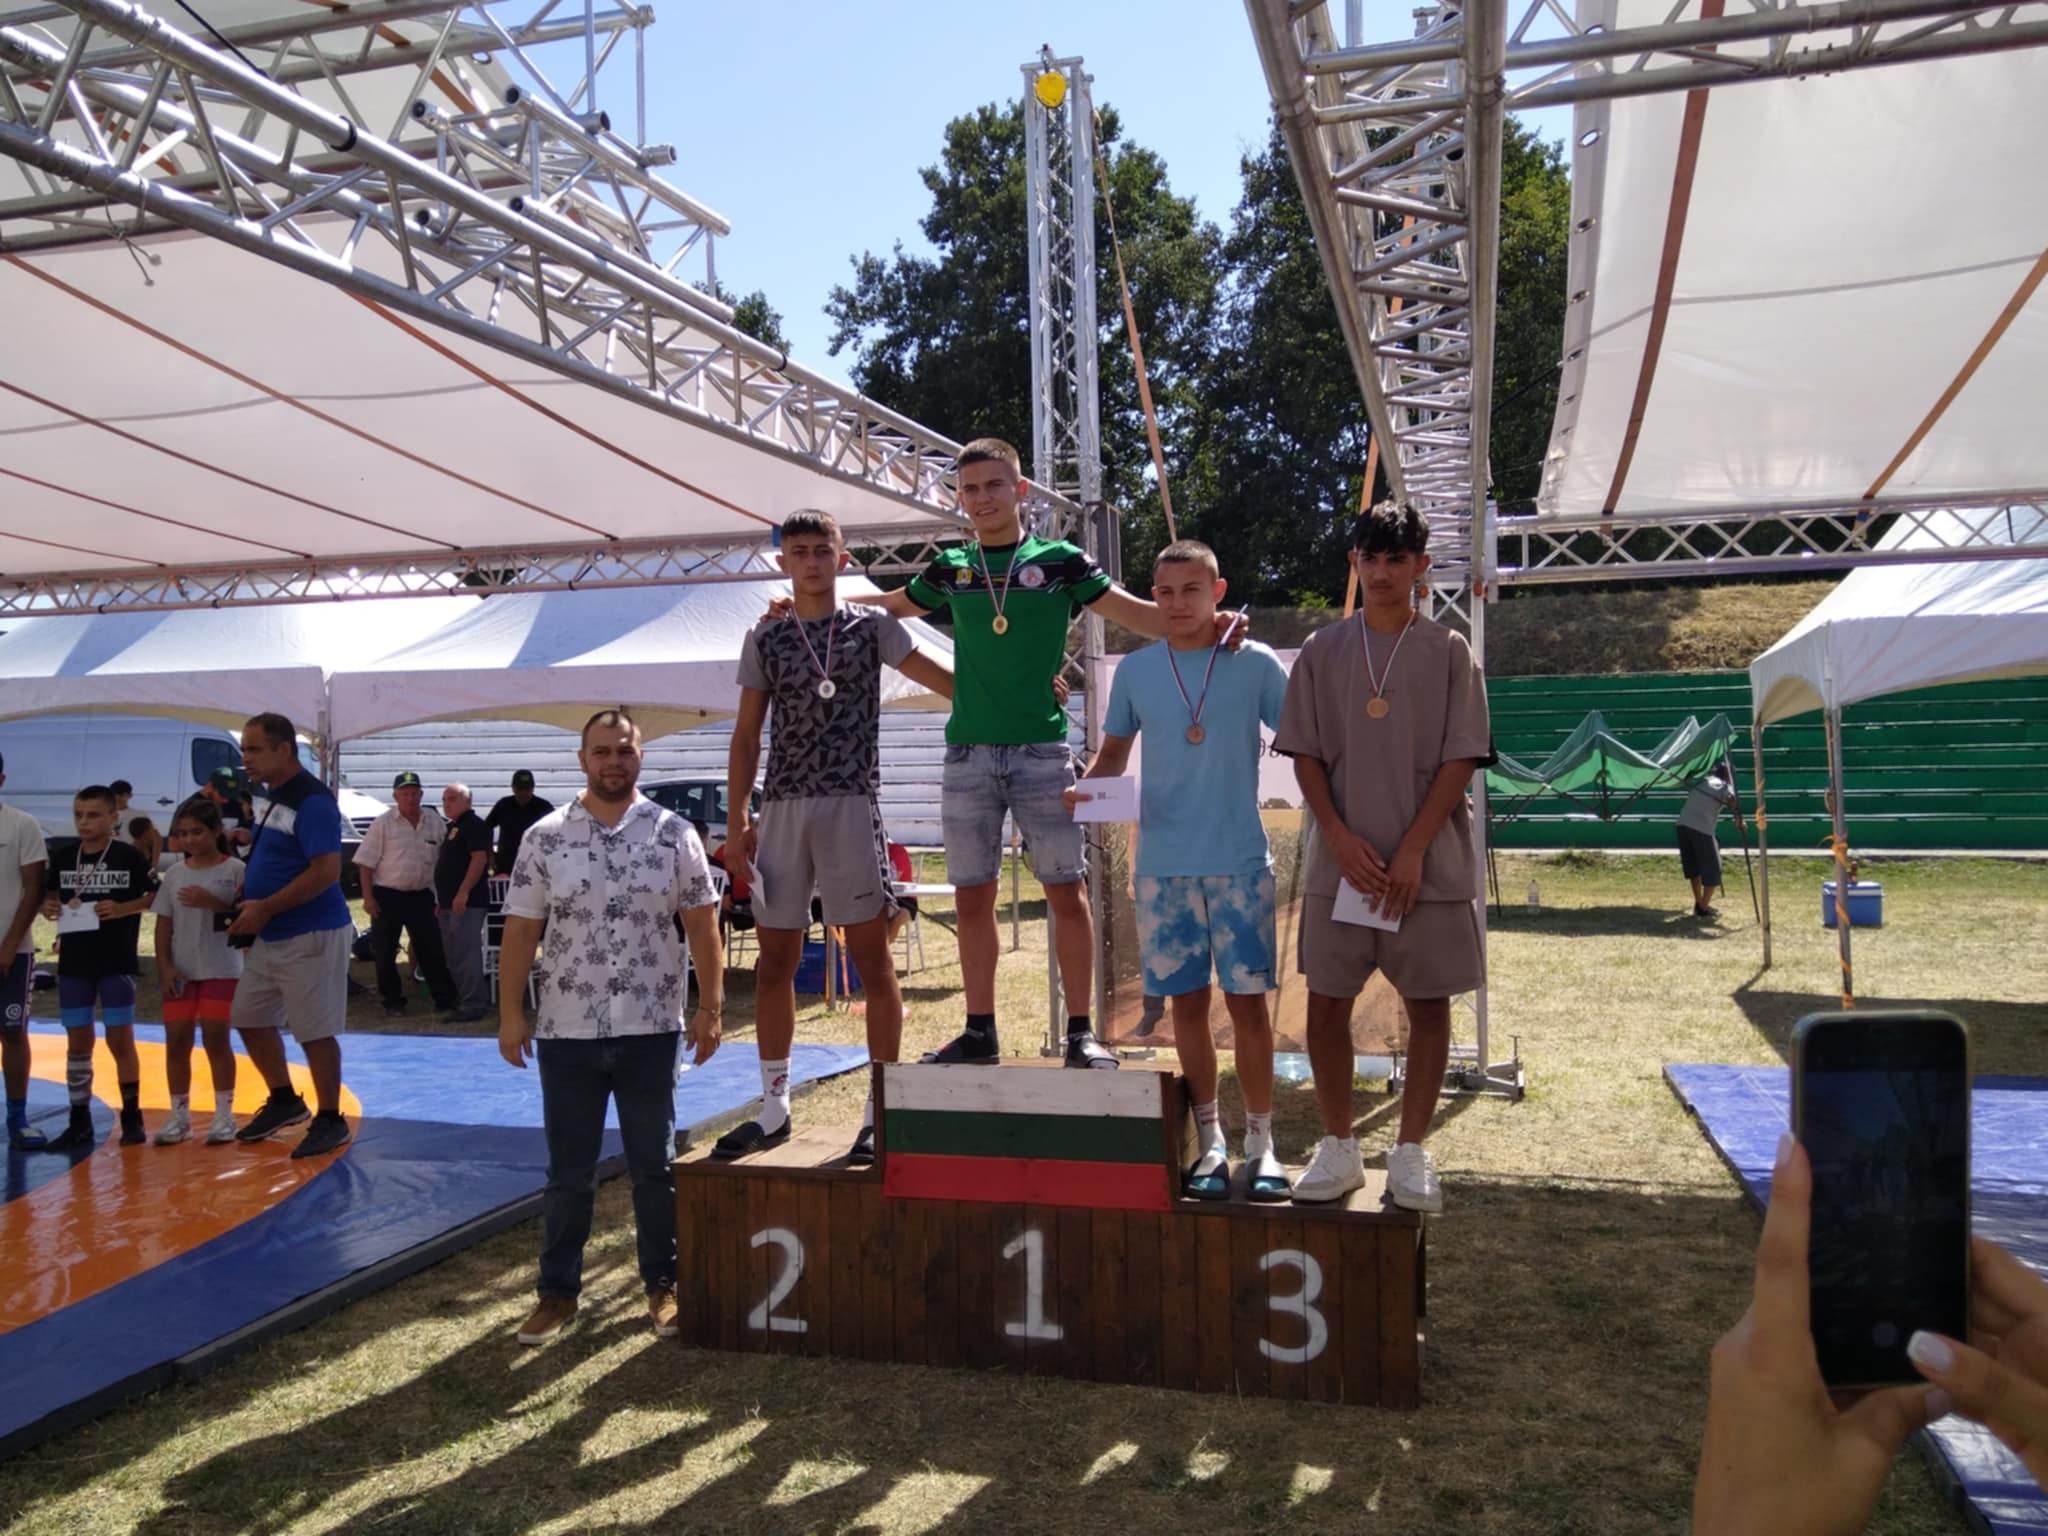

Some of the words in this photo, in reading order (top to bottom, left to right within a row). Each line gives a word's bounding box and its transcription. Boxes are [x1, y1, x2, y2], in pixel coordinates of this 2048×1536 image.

[748, 1228, 808, 1333] 2
[1003, 1230, 1063, 1340] 1
[1259, 1249, 1328, 1362] 3
